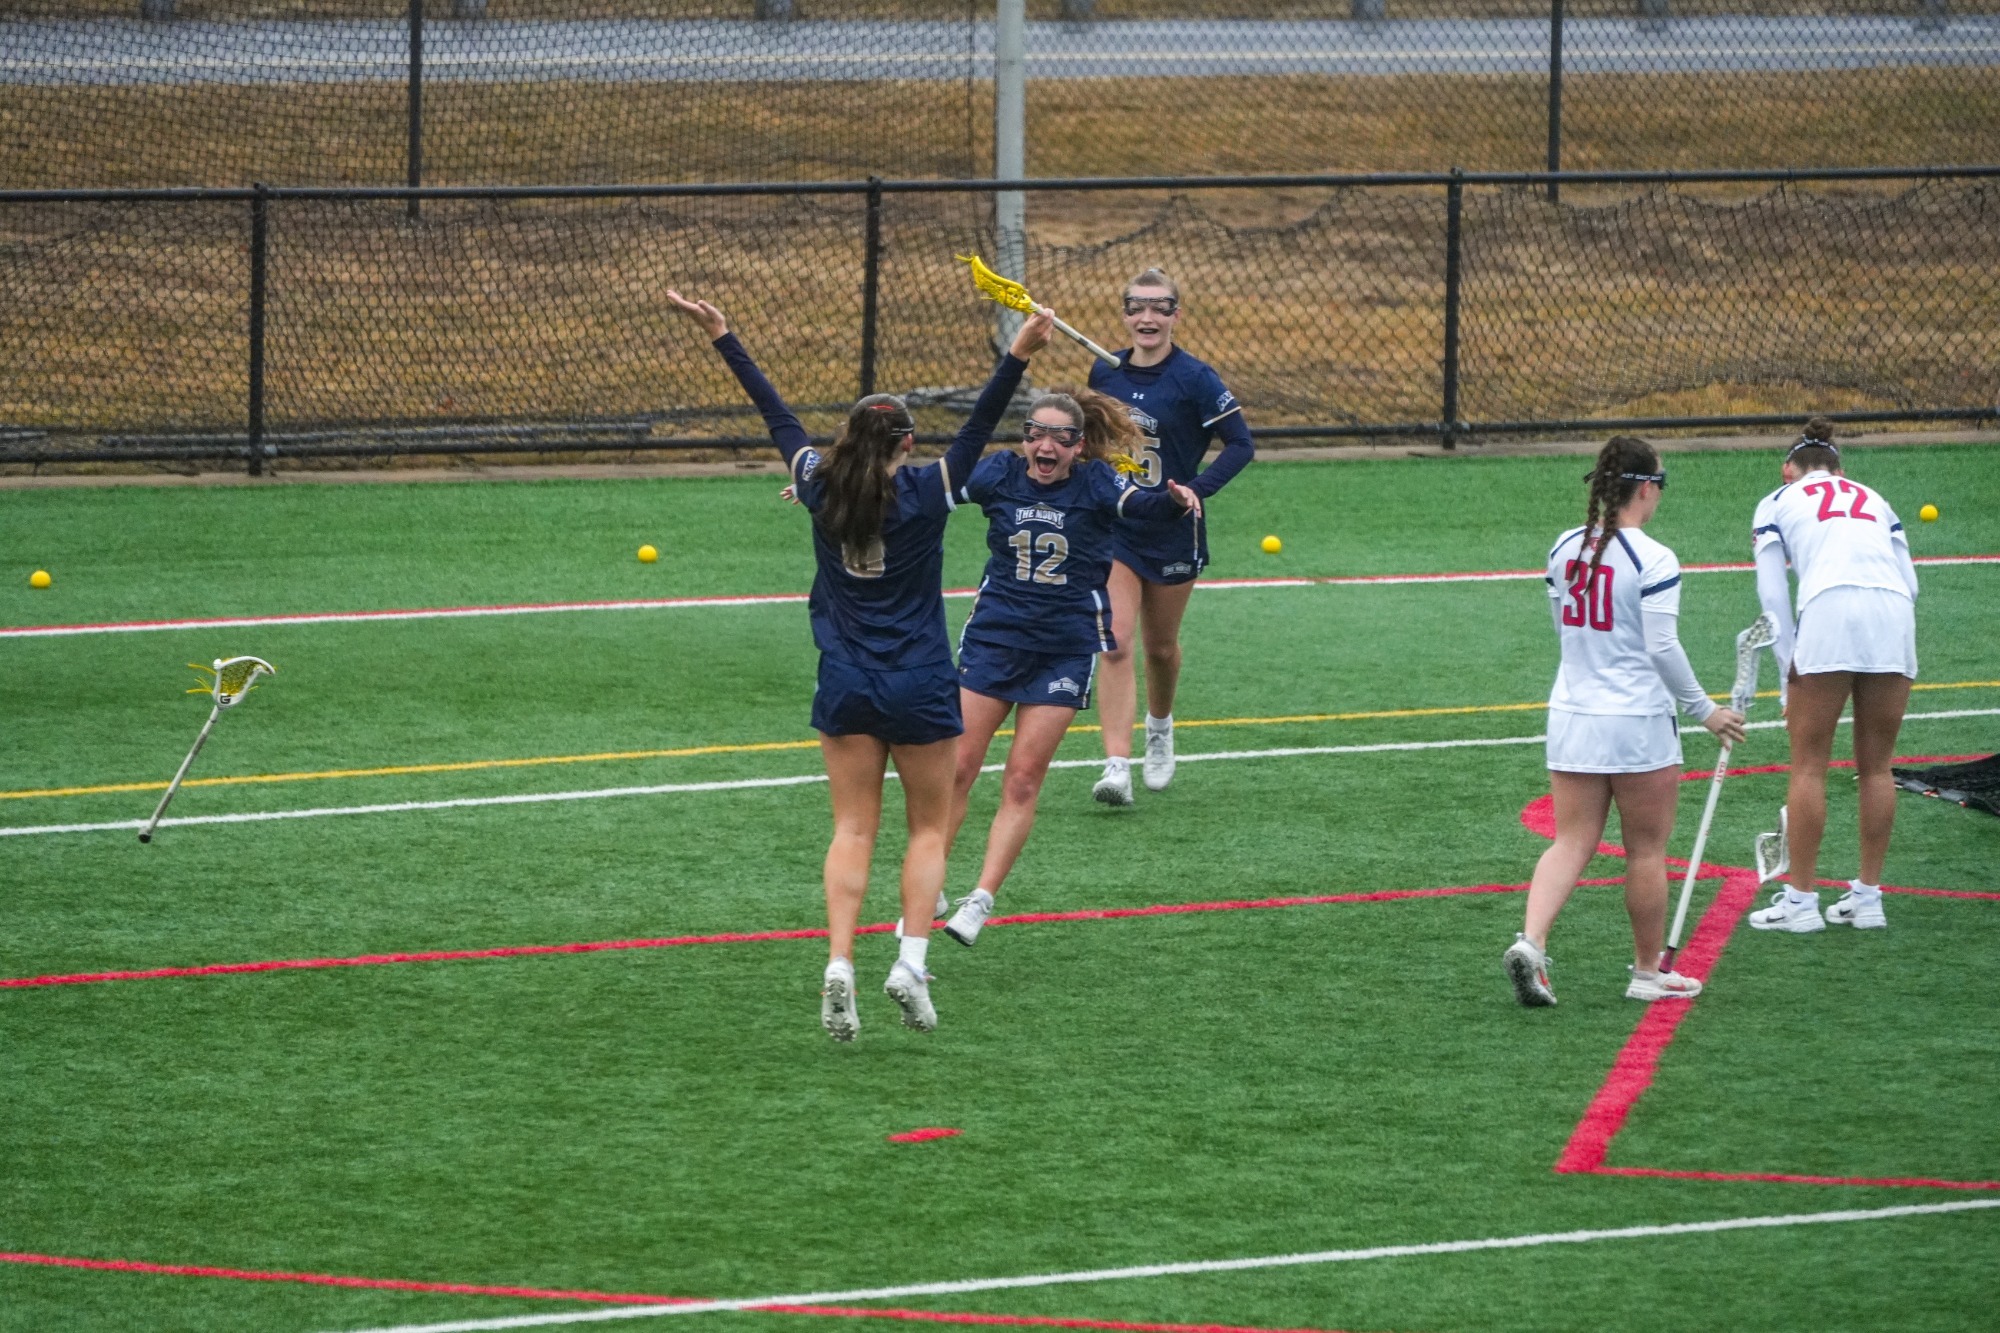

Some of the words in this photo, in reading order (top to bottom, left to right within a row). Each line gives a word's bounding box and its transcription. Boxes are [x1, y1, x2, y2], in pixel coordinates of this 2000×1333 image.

[1119, 436, 1162, 488] 5
[1018, 509, 1035, 521] THE
[1035, 509, 1065, 526] MOUNT
[1802, 480, 1877, 523] 22
[1008, 530, 1069, 585] 12
[1563, 559, 1615, 632] 30
